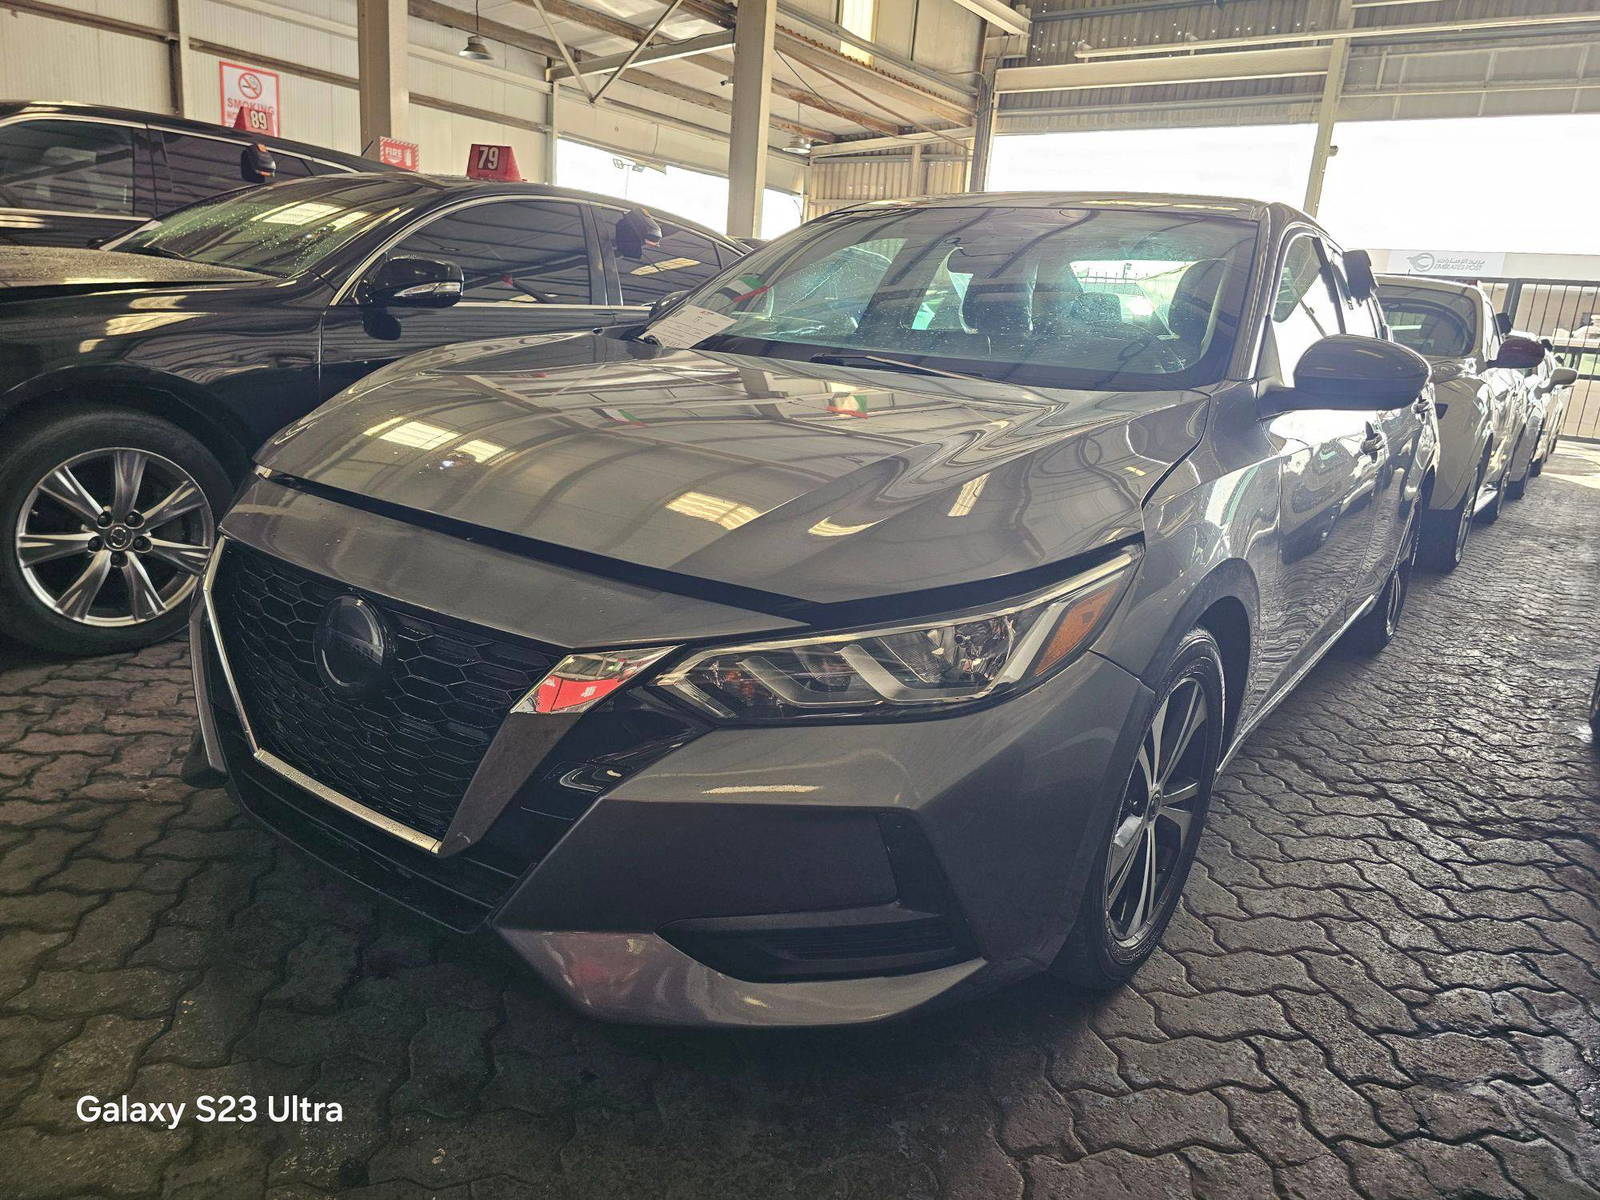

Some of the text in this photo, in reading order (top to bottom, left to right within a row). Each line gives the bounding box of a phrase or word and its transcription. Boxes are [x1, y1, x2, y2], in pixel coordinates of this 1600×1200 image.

[227, 97, 275, 115] SMOKING
[250, 110, 268, 130] 89
[385, 146, 403, 157] FIRE
[478, 146, 499, 170] 79
